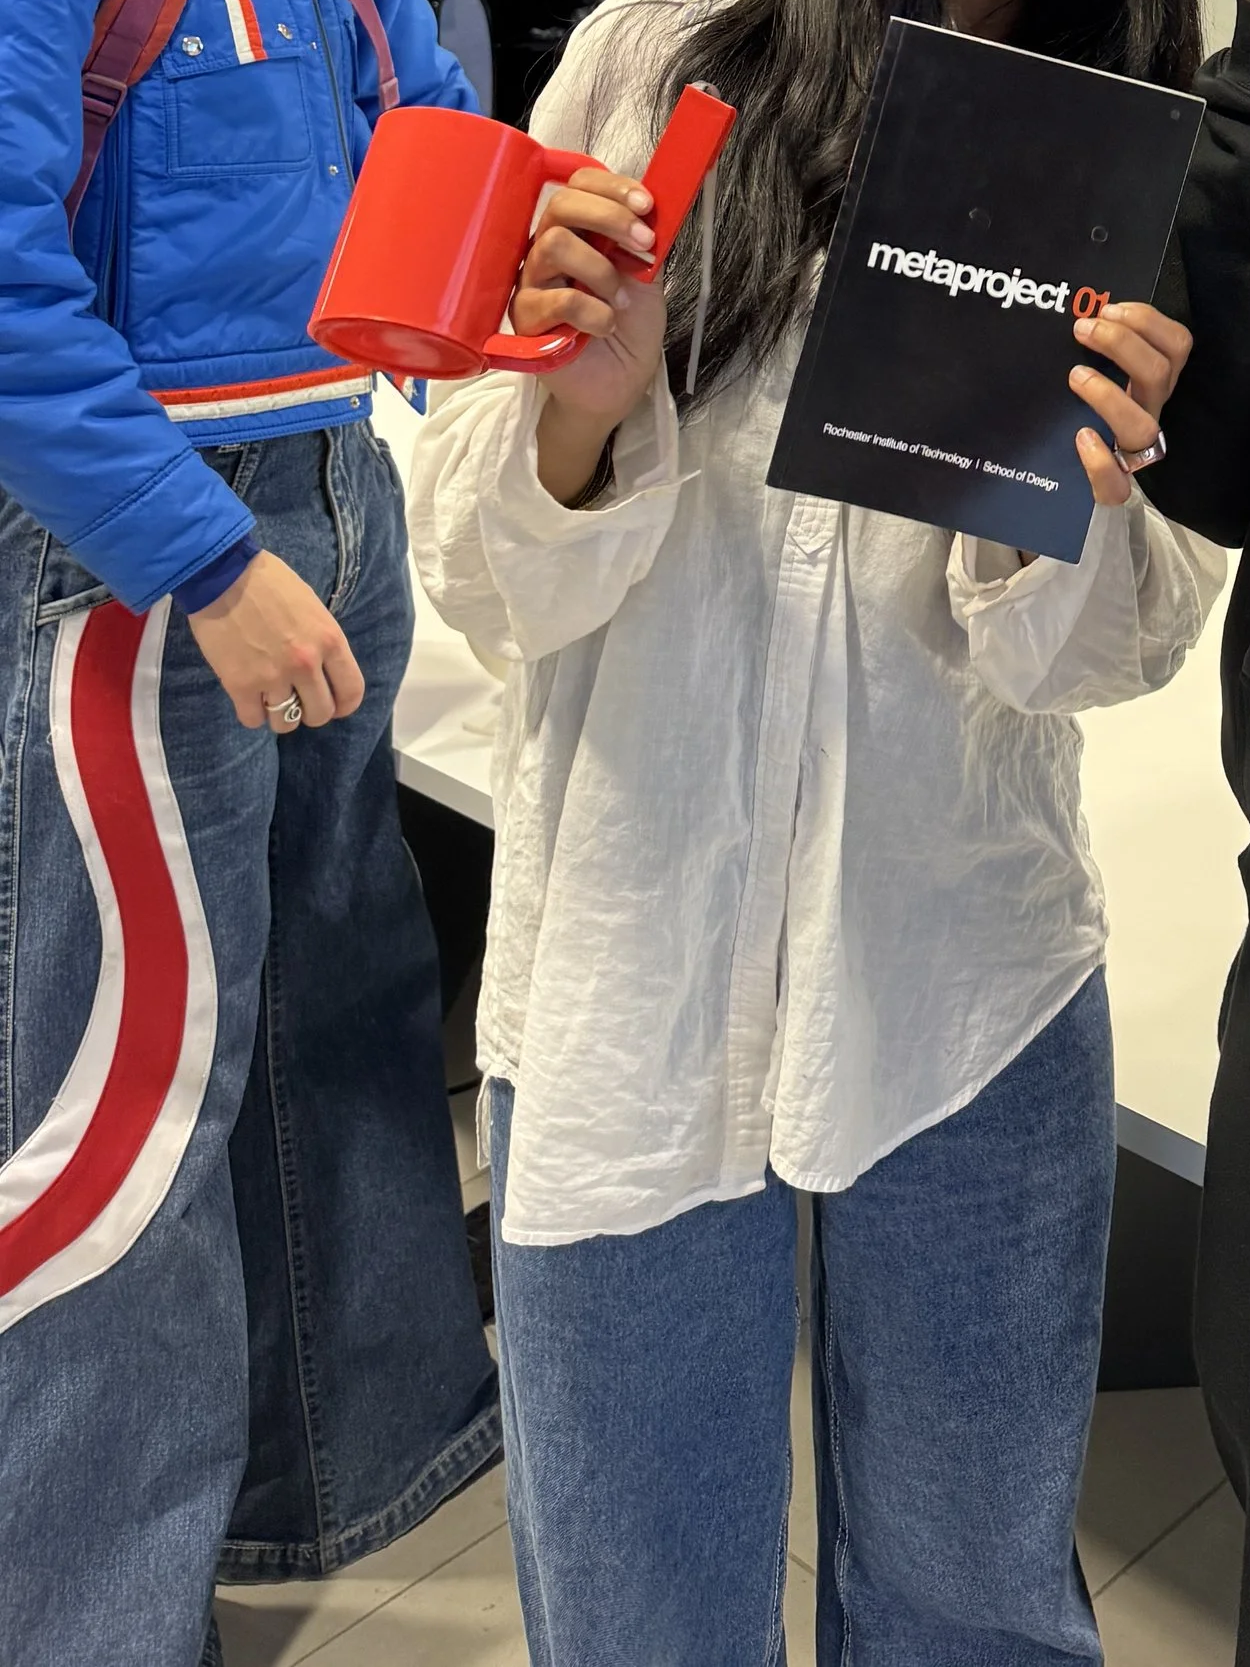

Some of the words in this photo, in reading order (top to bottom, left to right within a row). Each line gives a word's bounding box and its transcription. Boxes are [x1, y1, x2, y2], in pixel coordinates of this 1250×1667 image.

[867, 242, 1070, 313] metaproject
[823, 423, 872, 443] Rochester
[873, 434, 907, 452] Institute
[909, 444, 919, 453] of
[920, 445, 972, 469] Technology
[983, 460, 1015, 479] School
[1016, 471, 1026, 481] of
[1027, 473, 1059, 492] Design
